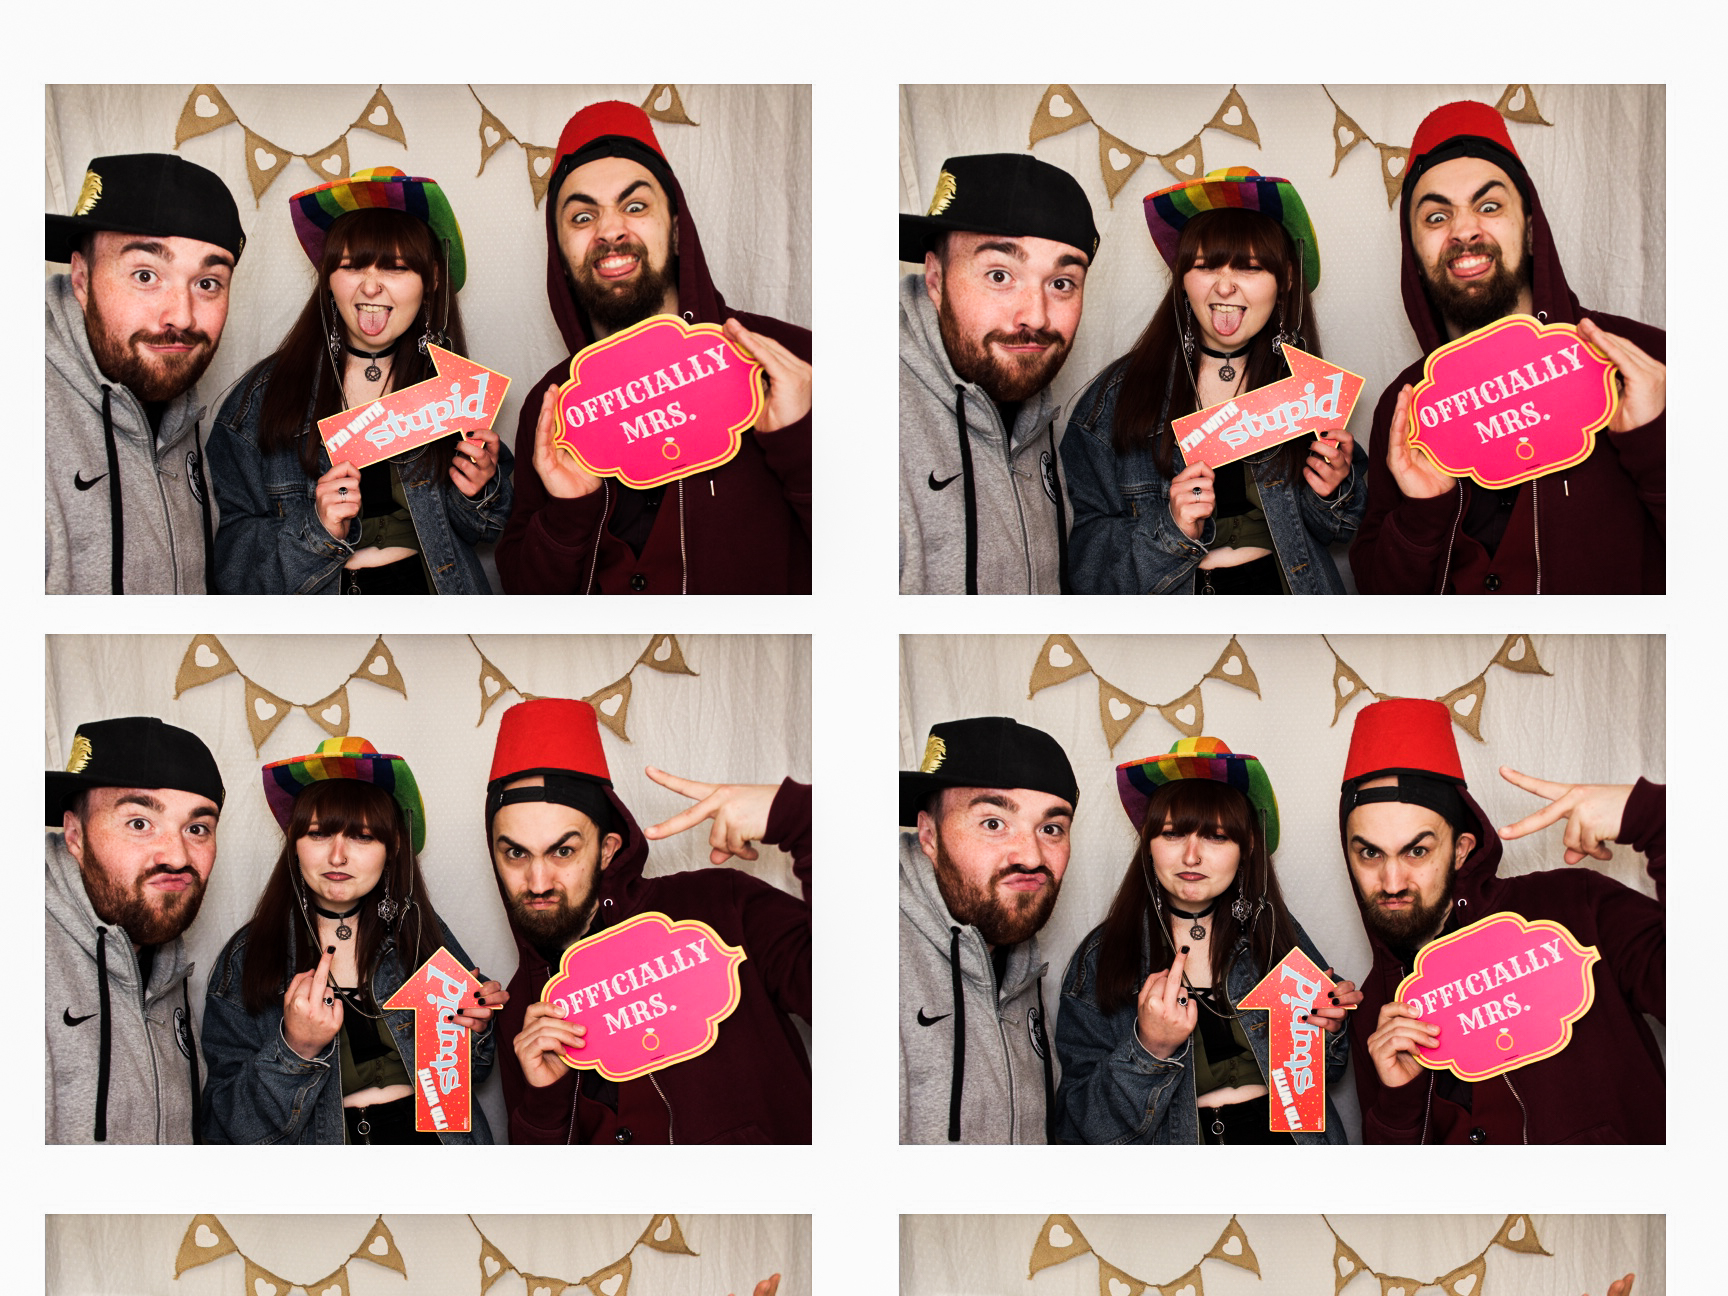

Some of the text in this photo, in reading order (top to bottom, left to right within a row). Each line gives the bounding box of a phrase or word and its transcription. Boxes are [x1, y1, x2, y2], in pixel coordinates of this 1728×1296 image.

[566, 343, 730, 428] OFFICIALLY
[1420, 343, 1584, 428] OFFICIALLY
[346, 401, 386, 434] WITH
[365, 372, 490, 450] stupid
[620, 401, 697, 444] MRS.
[1200, 401, 1240, 434] WITH
[1219, 372, 1344, 450] stupid
[1474, 401, 1551, 444] MRS.
[426, 963, 468, 1095] stupid
[602, 992, 677, 1036] MRS.
[1280, 963, 1322, 1095] stupid
[1456, 992, 1531, 1036] MRS.
[417, 1068, 440, 1107] WITH
[1271, 1068, 1294, 1107] WITH
